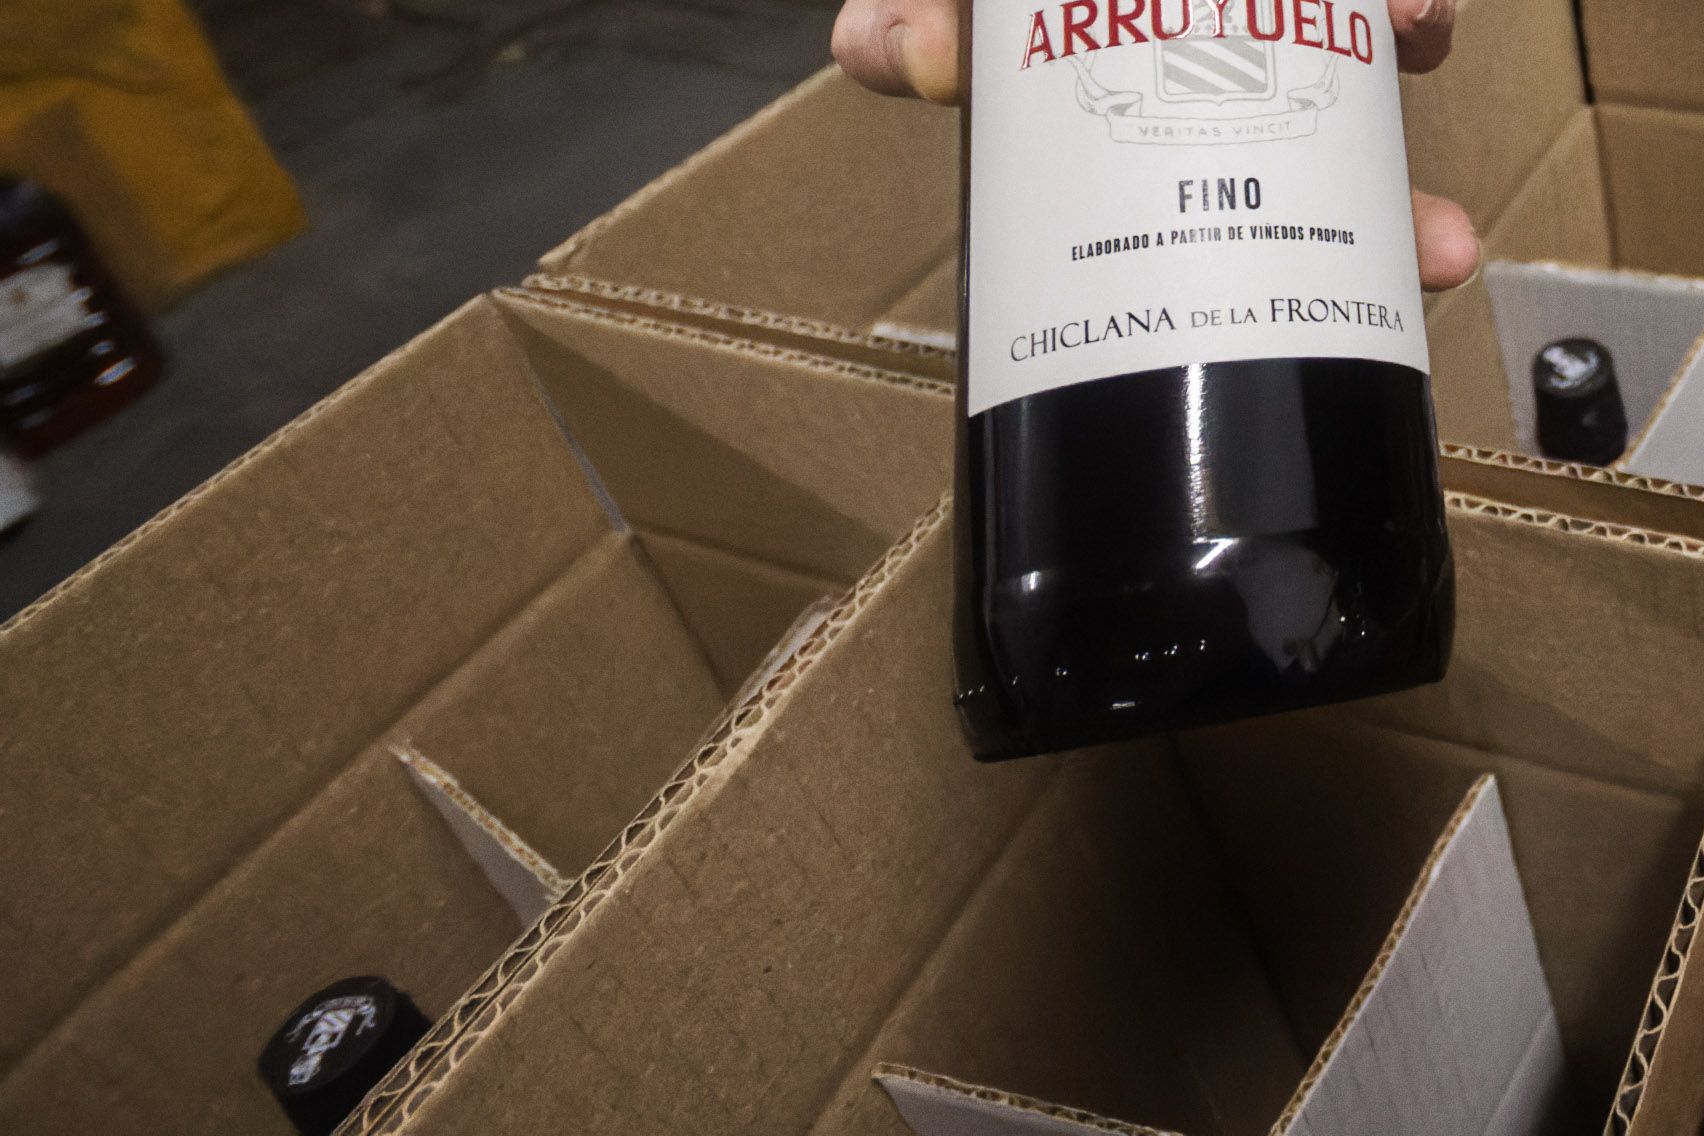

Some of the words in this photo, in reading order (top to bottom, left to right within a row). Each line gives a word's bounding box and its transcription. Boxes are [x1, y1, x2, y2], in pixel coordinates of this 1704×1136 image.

[1138, 125, 1223, 138] VERITAS
[1234, 120, 1292, 136] VINCIT
[1178, 177, 1262, 214] FINO
[1071, 233, 1149, 262] ELABORADO
[1156, 231, 1164, 247] A
[1170, 226, 1221, 245] PARTIR
[1227, 226, 1244, 241] DE
[1250, 222, 1304, 240] VIÑEDOS
[1309, 227, 1355, 246] PROPIOS
[1010, 307, 1177, 362] CHICLANA
[1190, 310, 1222, 328] DE
[1230, 307, 1257, 325] LA
[1269, 298, 1405, 333] FRONTERA
